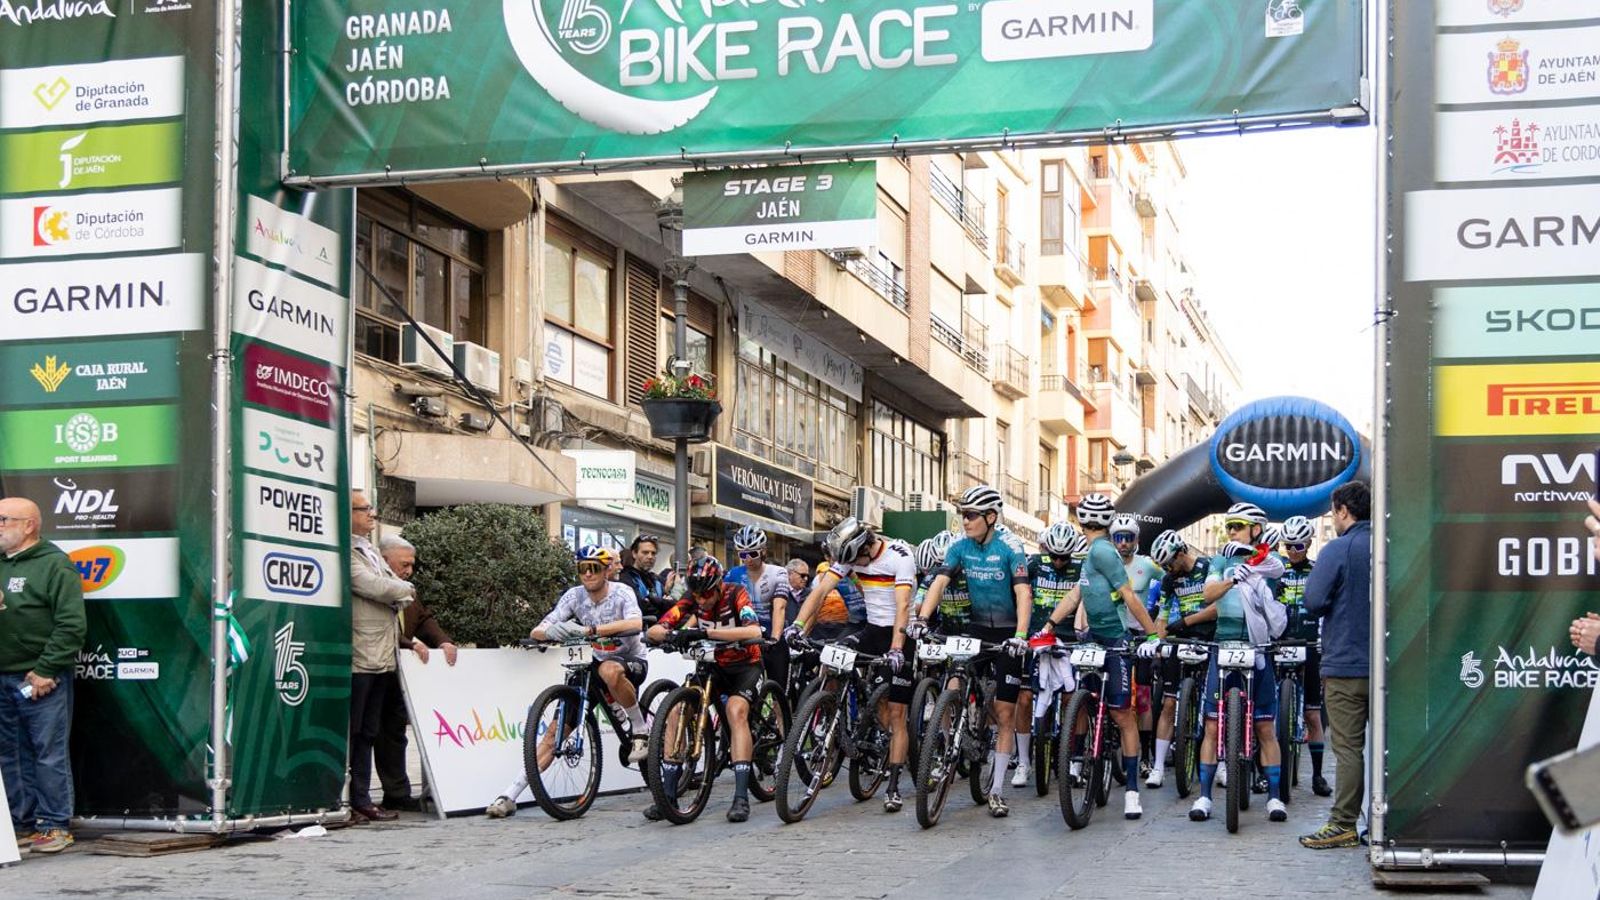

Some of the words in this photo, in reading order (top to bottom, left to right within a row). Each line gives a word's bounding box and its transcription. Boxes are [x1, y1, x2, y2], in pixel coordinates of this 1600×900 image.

[346, 8, 452, 40] GRANADA
[1001, 9, 1135, 40] GARMIN
[558, 27, 596, 39] YEARS
[619, 20, 758, 87] BIKE
[777, 4, 958, 76] RACE
[968, 3, 981, 12] BY
[346, 44, 403, 73] JAÉN
[1538, 73, 1556, 84] DE
[1560, 70, 1596, 84] JAÉN
[75, 82, 145, 99] Diputación
[346, 76, 451, 106] CÓRDOBA
[75, 100, 91, 111] de
[94, 95, 149, 110] Granada
[1543, 148, 1557, 162] DE
[724, 175, 807, 196] STAGE
[815, 174, 833, 190] 3
[756, 197, 801, 219] JAÉN
[76, 210, 144, 226] Diputación
[75, 229, 91, 240] de
[94, 226, 144, 240] Córdoba
[744, 230, 814, 245] GARMIN
[14, 281, 164, 314] GARMIN
[248, 290, 334, 336] GARMIN
[76, 364, 104, 376] CAJA
[108, 362, 148, 375] RURAL
[96, 377, 127, 391] JAÉN
[274, 367, 330, 397] IMDECO
[54, 456, 79, 464] SPORT
[80, 454, 118, 463] BEARINGS
[580, 467, 627, 479] TECNOCASA
[731, 465, 773, 494] VERÓNICA
[773, 480, 780, 497] Y
[781, 484, 802, 504] JESÚS
[54, 489, 119, 514] NDL
[260, 486, 322, 515] POWER
[288, 513, 323, 535] ADE
[266, 560, 315, 588] CRUZ
[926, 645, 942, 656] 8-2
[955, 639, 972, 651] 1-2
[568, 647, 583, 661] 9-1
[831, 650, 846, 665] 1-1
[1080, 650, 1096, 662] 7-1
[1228, 651, 1246, 664] 7-2
[75, 665, 114, 680] RACE
[1494, 670, 1539, 688] BIKE
[1545, 670, 1600, 688] RACE
